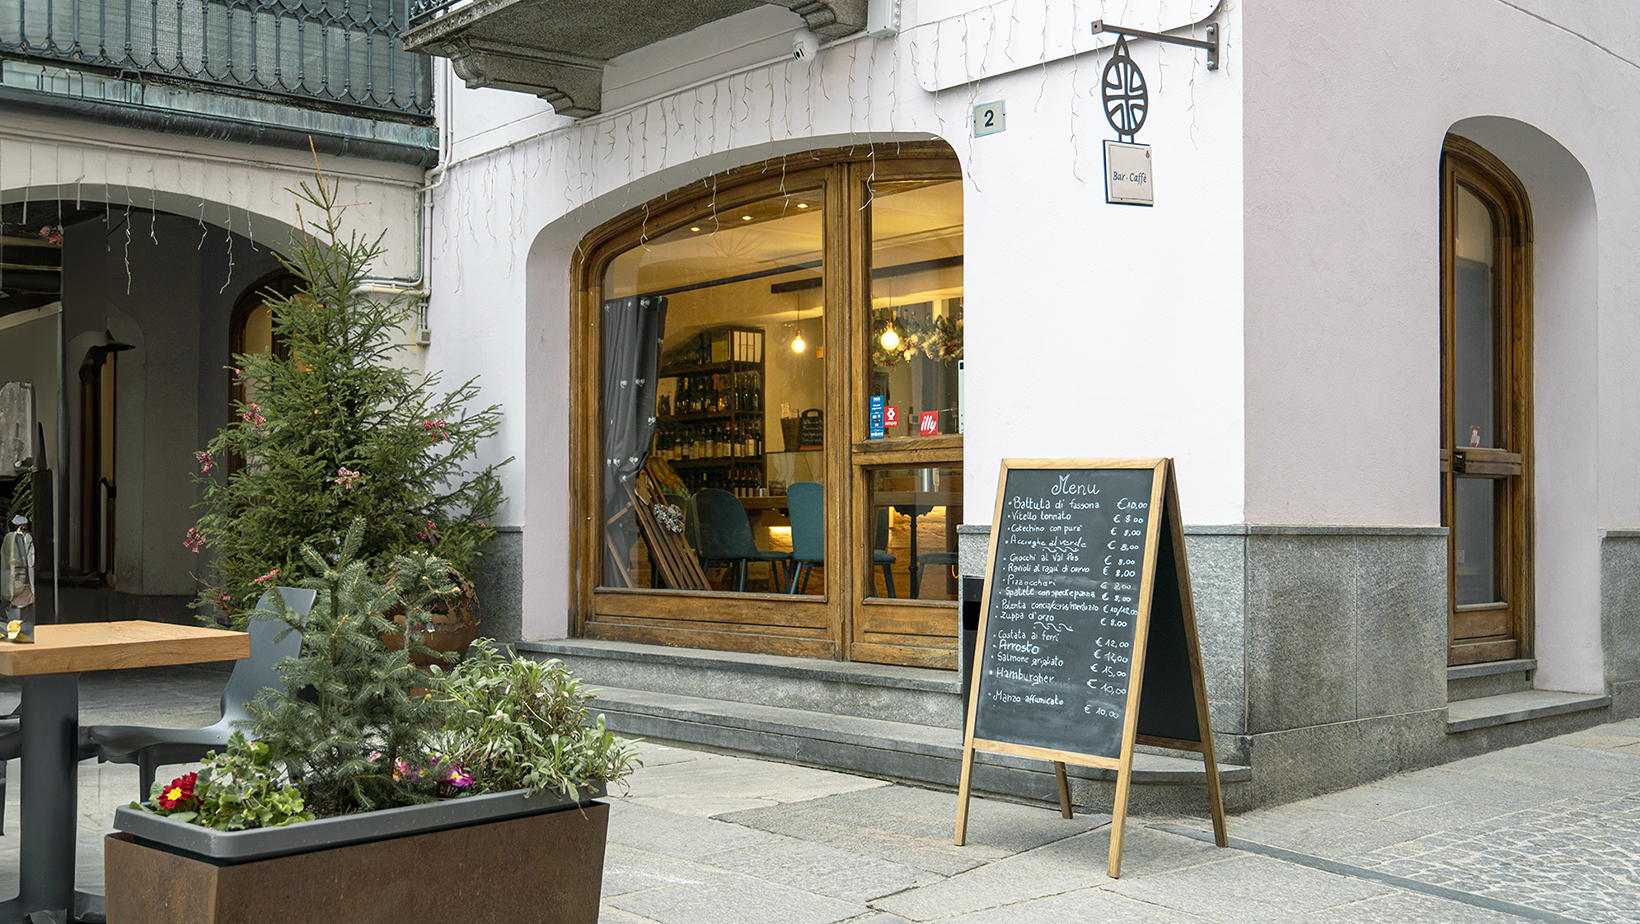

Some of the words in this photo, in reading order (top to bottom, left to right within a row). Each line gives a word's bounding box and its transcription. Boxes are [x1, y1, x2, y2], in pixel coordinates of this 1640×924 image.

[984, 109, 994, 127] 2
[920, 415, 937, 434] illy
[1051, 474, 1100, 495] Menu
[1012, 496, 1050, 510] Battuta
[1054, 499, 1064, 509] di
[1011, 510, 1037, 521] Vitello
[1011, 524, 1045, 532] Cotechino
[1049, 536, 1057, 546] al
[1059, 537, 1087, 548] verde
[1041, 554, 1049, 562] al
[1052, 553, 1063, 562] Val
[1001, 598, 1026, 609] Polenta
[1000, 612, 1024, 622] Zuppa
[998, 629, 1026, 640] Costata
[1042, 632, 1060, 642] ferri
[999, 639, 1040, 655] Arrosto
[997, 651, 1029, 664] Salmone
[996, 667, 1055, 686] Hamburgher
